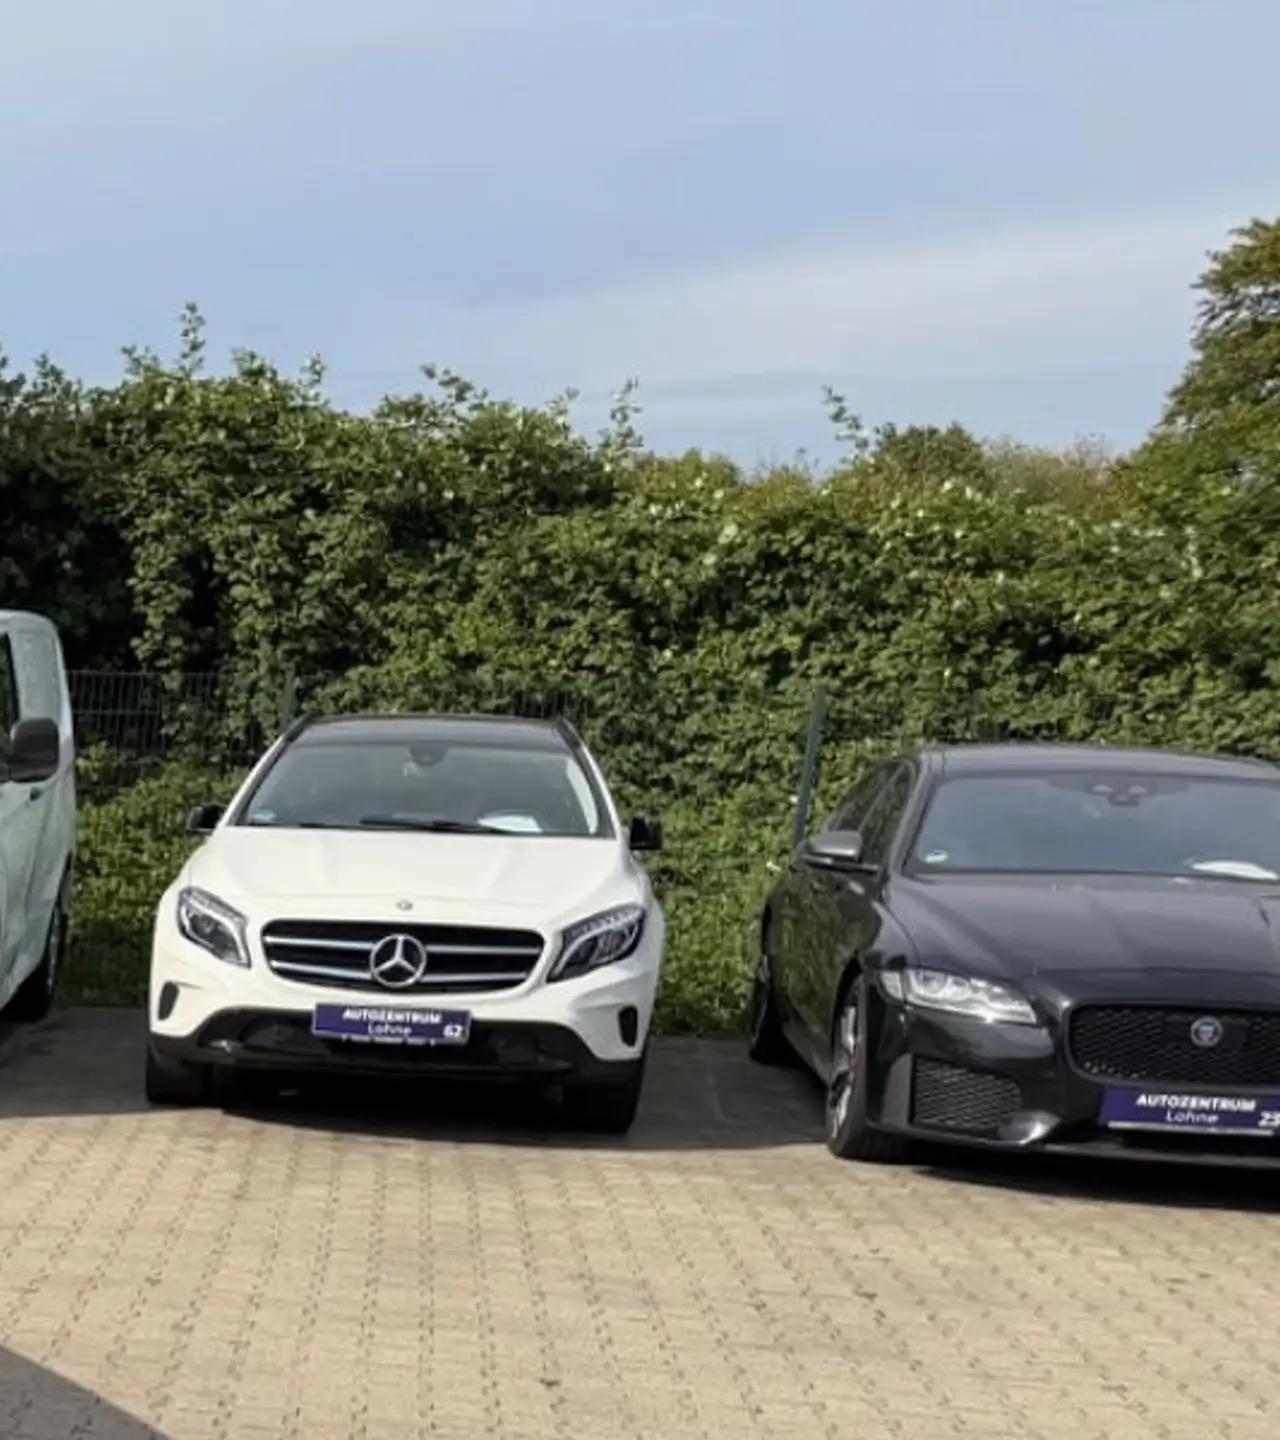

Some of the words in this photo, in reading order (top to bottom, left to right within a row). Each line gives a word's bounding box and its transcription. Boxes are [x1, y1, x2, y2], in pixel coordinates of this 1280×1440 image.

[343, 1008, 441, 1024] AUTOZENTRUM
[1135, 1094, 1257, 1113] AUTOZENTRUM
[1166, 1109, 1219, 1123] Lohne
